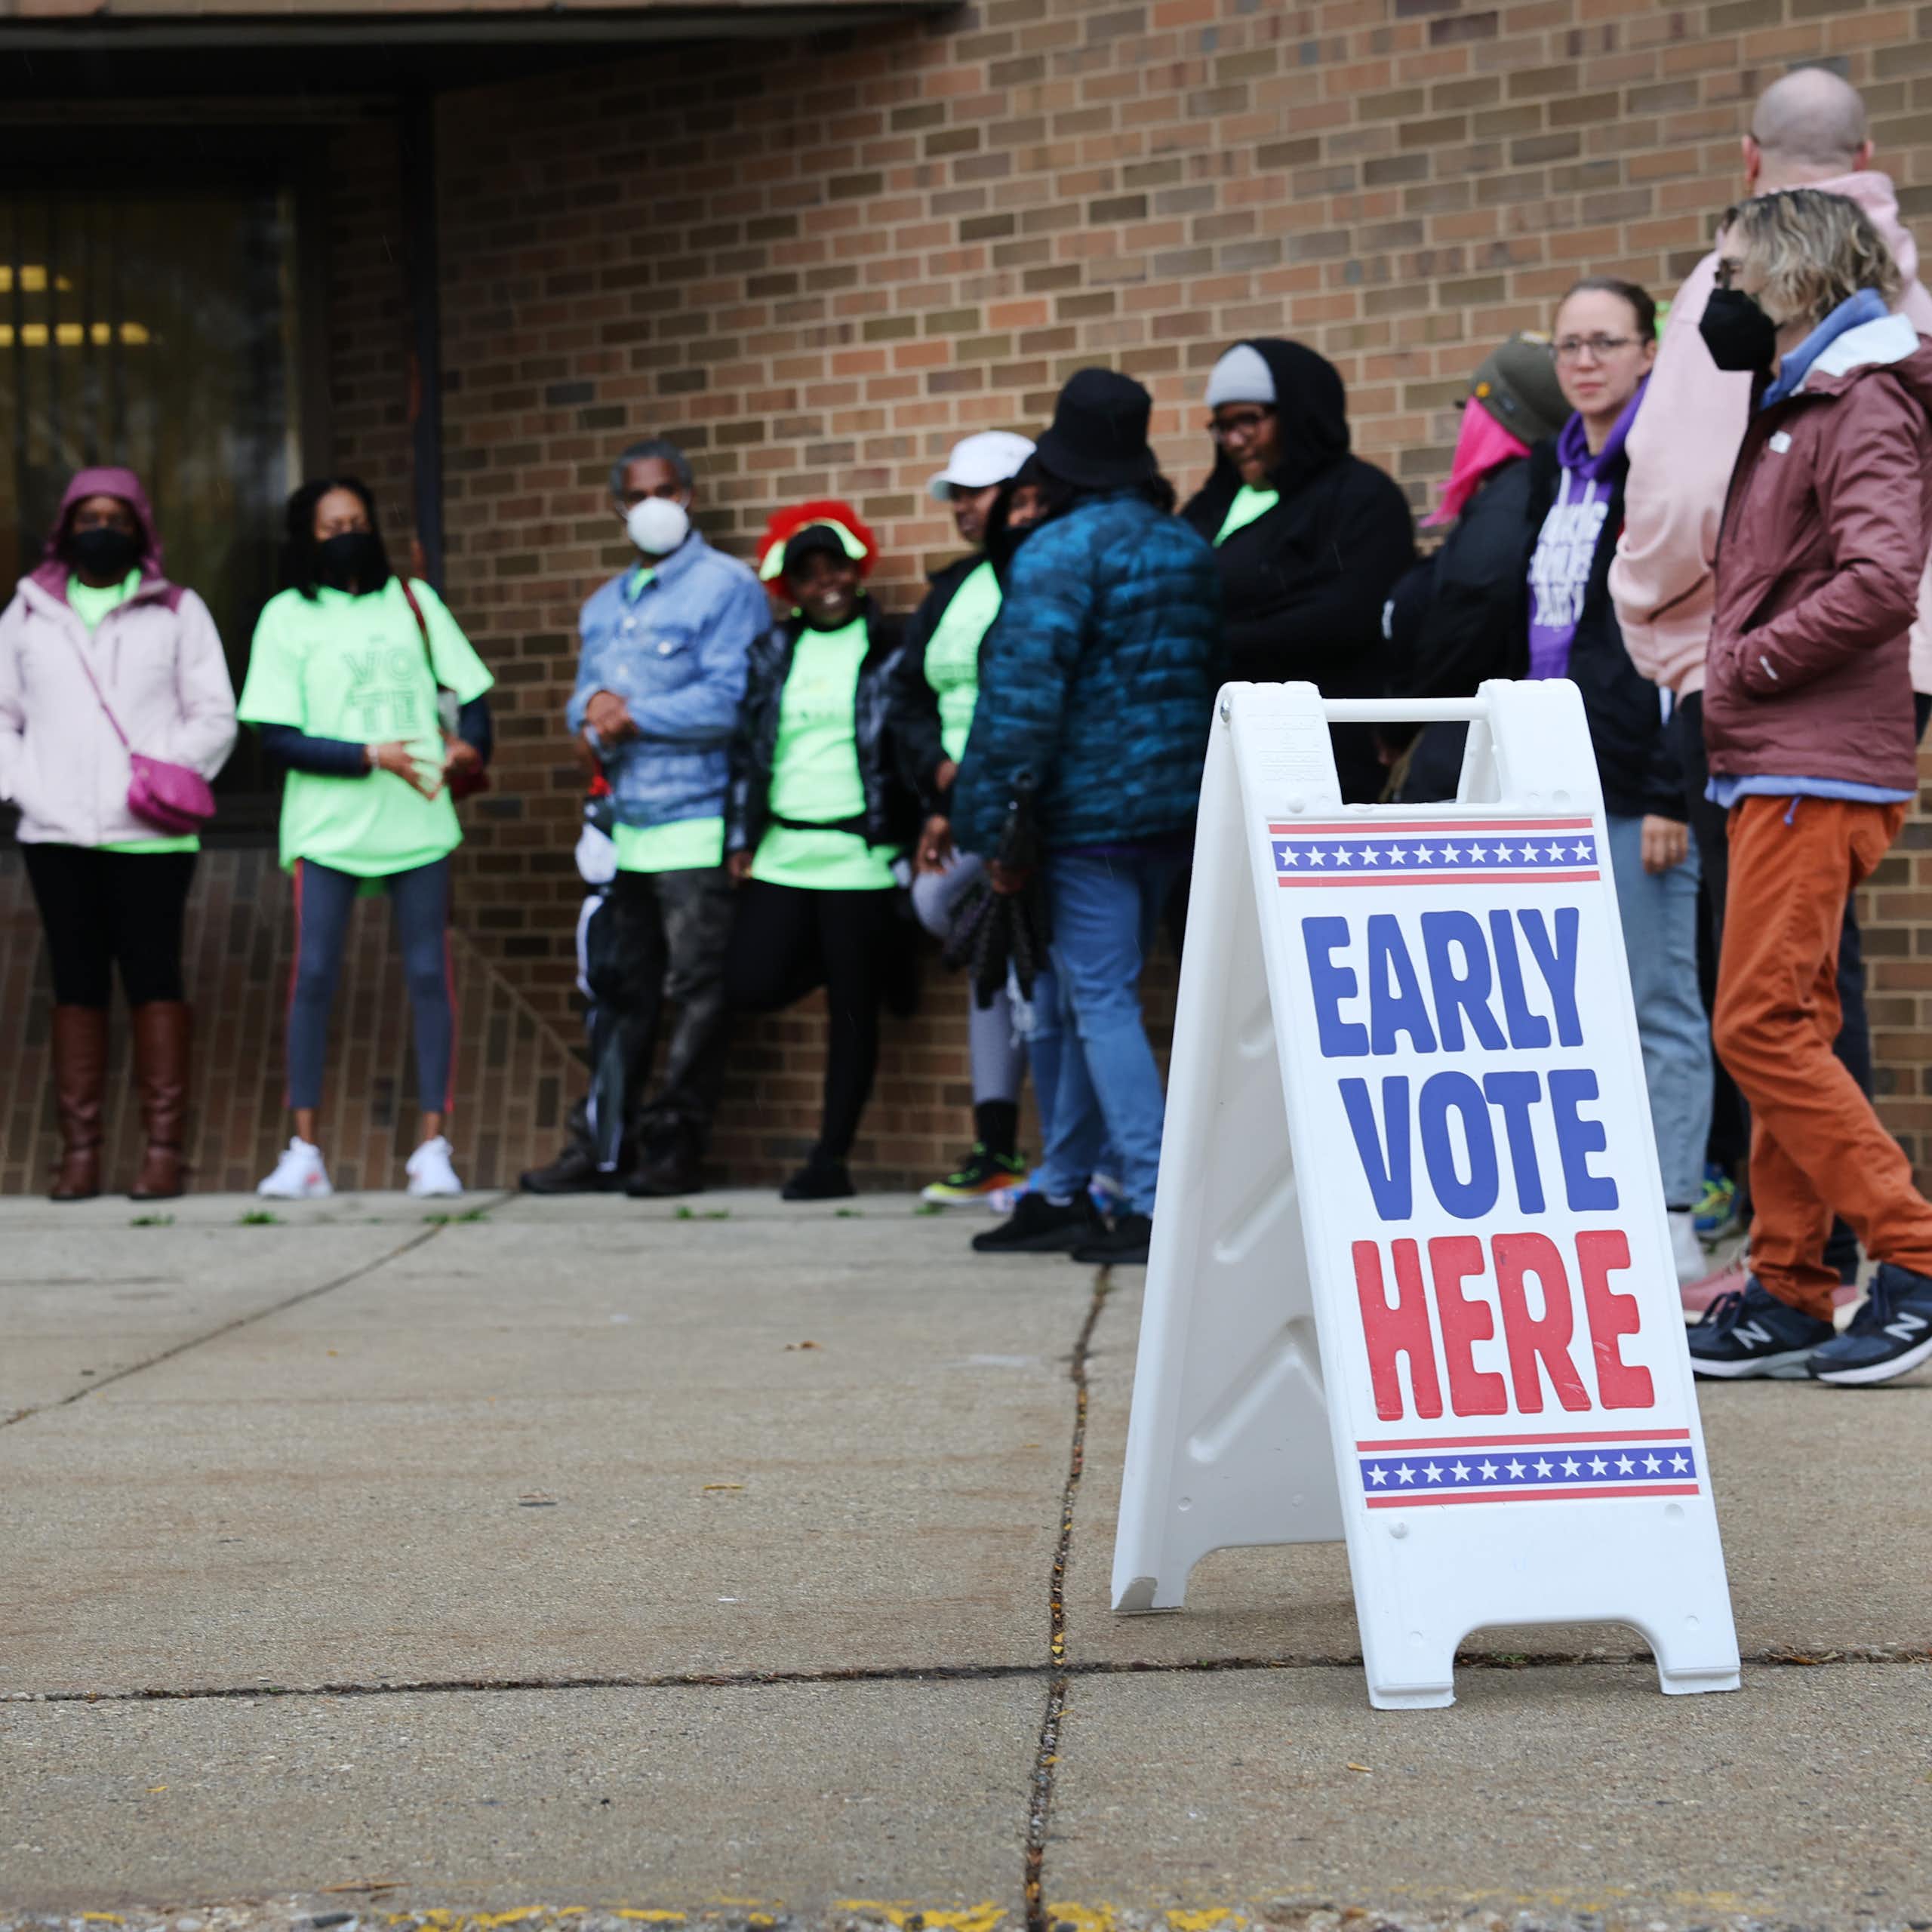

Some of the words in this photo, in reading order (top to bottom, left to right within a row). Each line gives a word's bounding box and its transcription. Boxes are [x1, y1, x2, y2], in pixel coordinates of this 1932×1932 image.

[1301, 907, 1583, 1058] EARLY
[1338, 1069, 1619, 1221] VOTE
[1352, 1229, 1655, 1421] HERE
[1732, 1321, 1773, 1349] N
[1884, 1312, 1928, 1341] N
